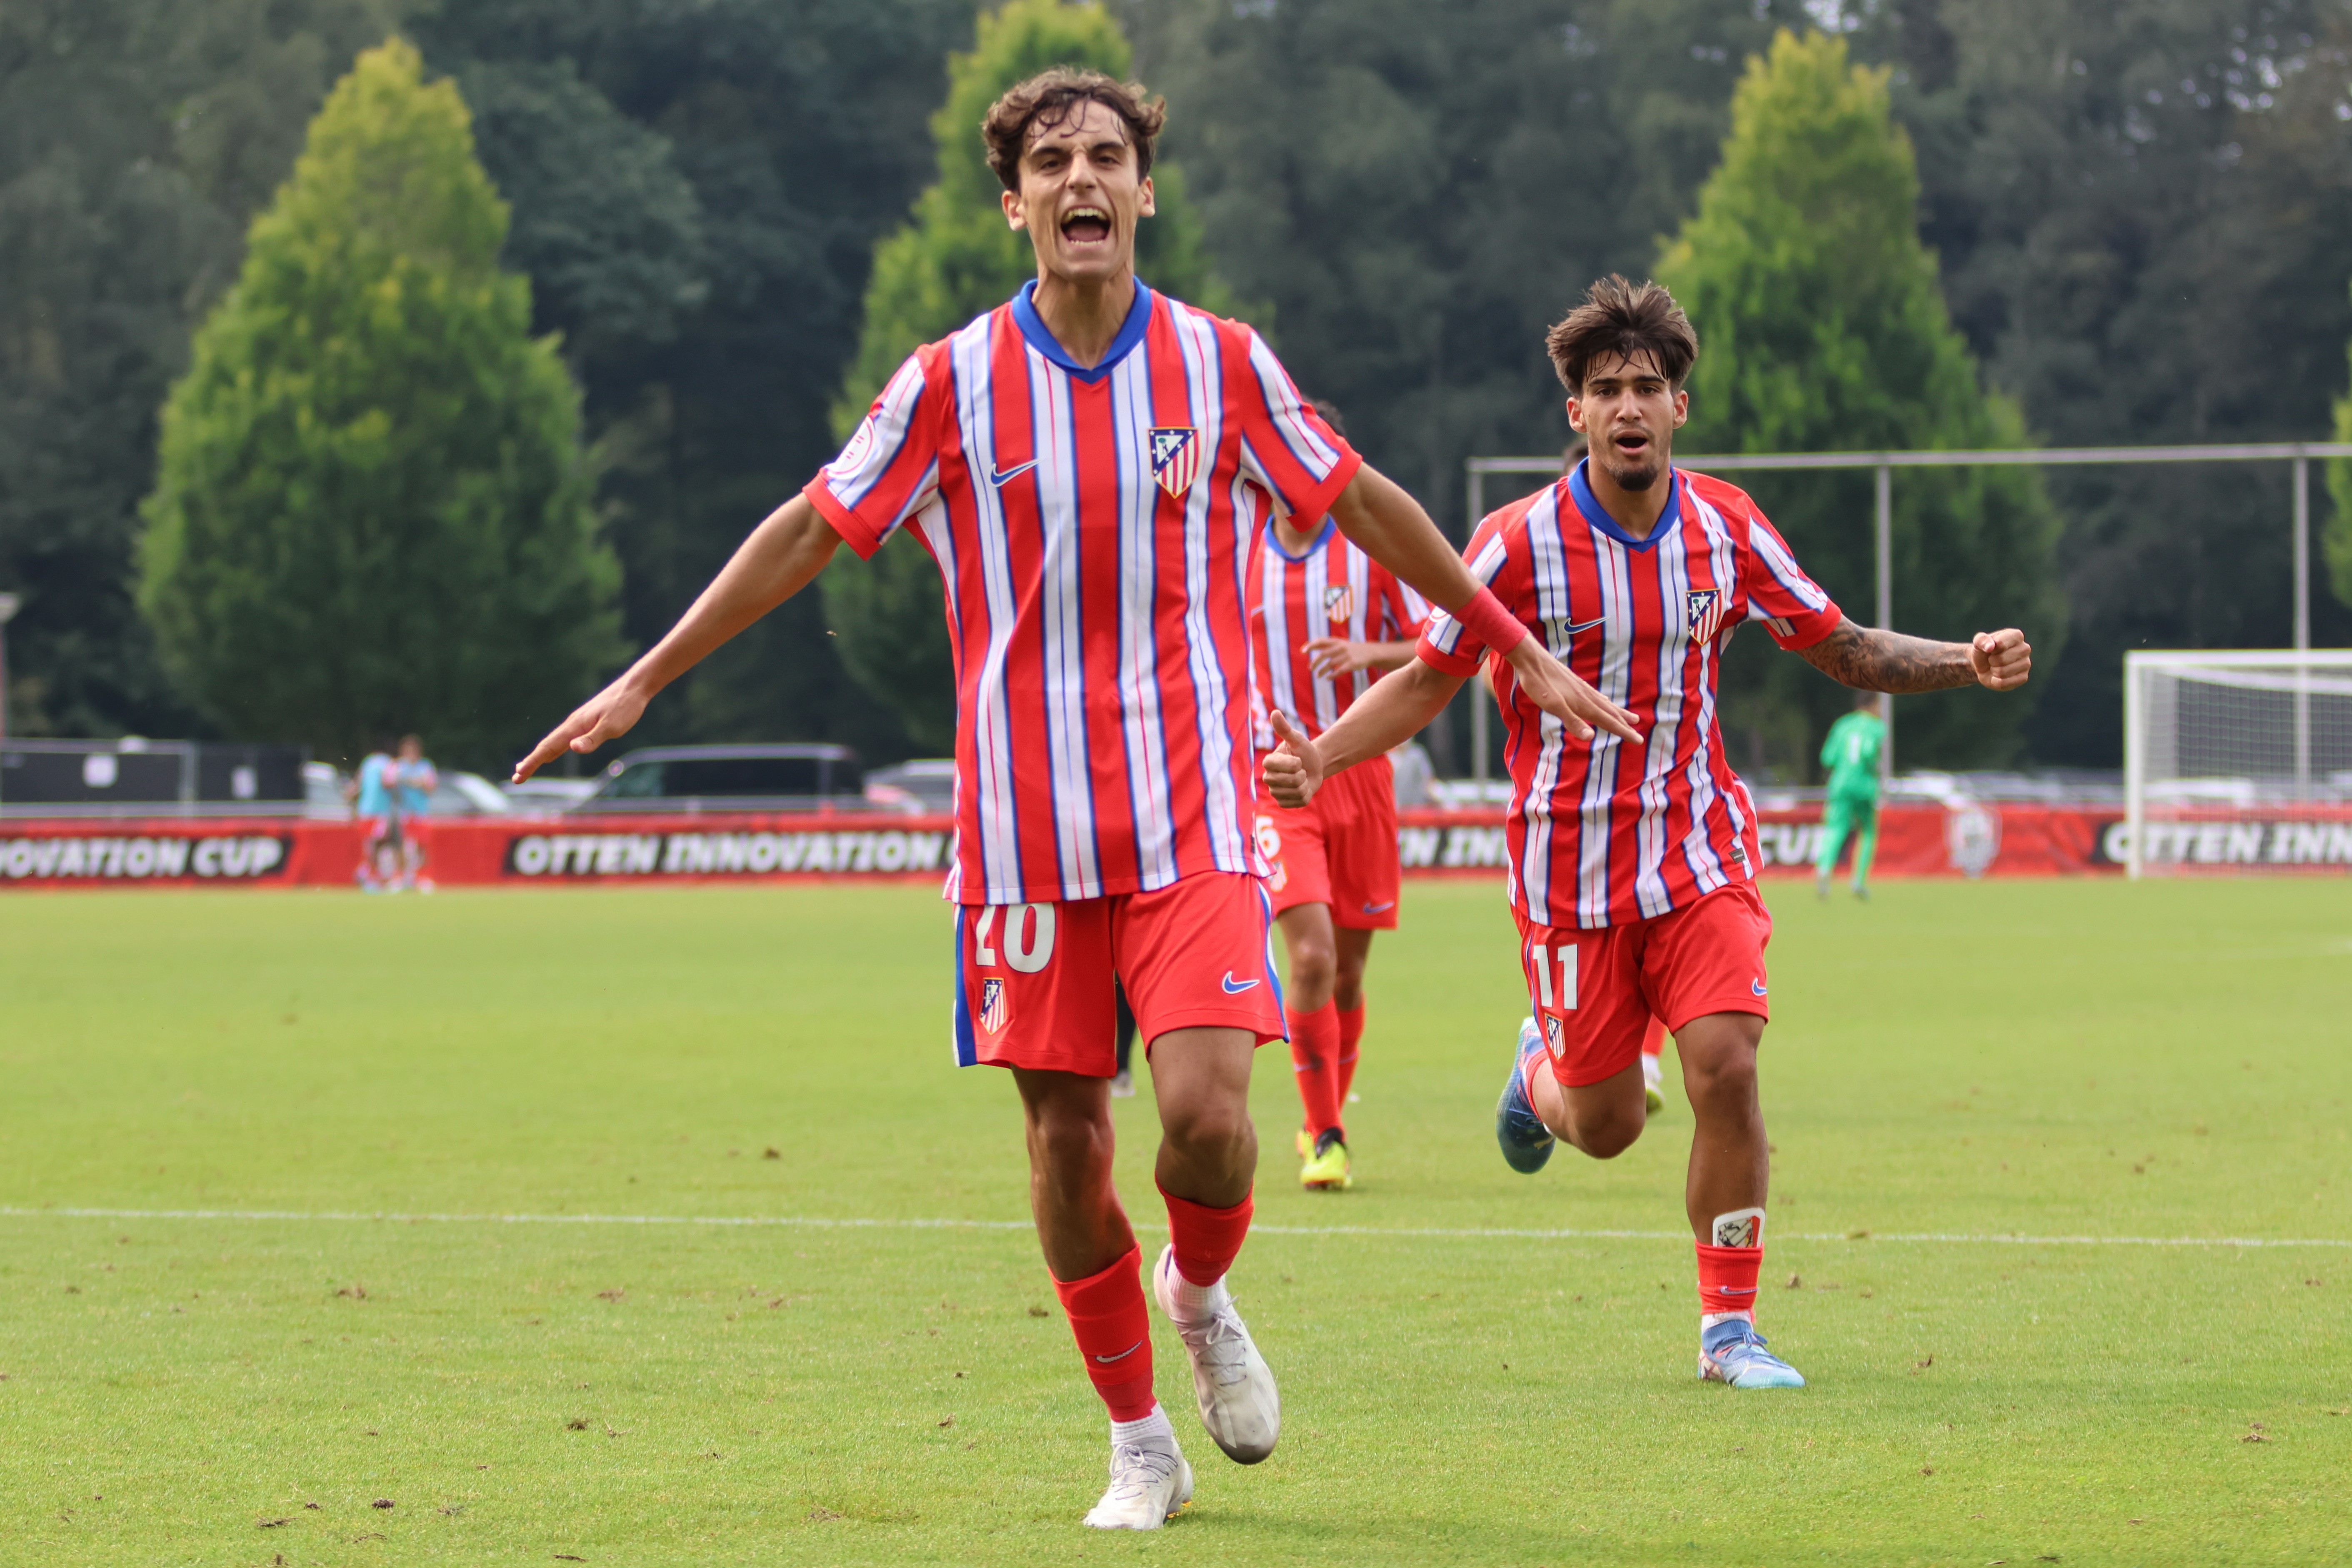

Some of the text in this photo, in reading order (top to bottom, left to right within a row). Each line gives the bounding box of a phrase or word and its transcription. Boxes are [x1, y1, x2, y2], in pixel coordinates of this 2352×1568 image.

[191, 835, 284, 878] CUP
[513, 833, 662, 876] OTTEN
[660, 830, 943, 873] INNOVATION
[2102, 820, 2264, 864] OTTEN
[1532, 943, 1578, 1010] 11
